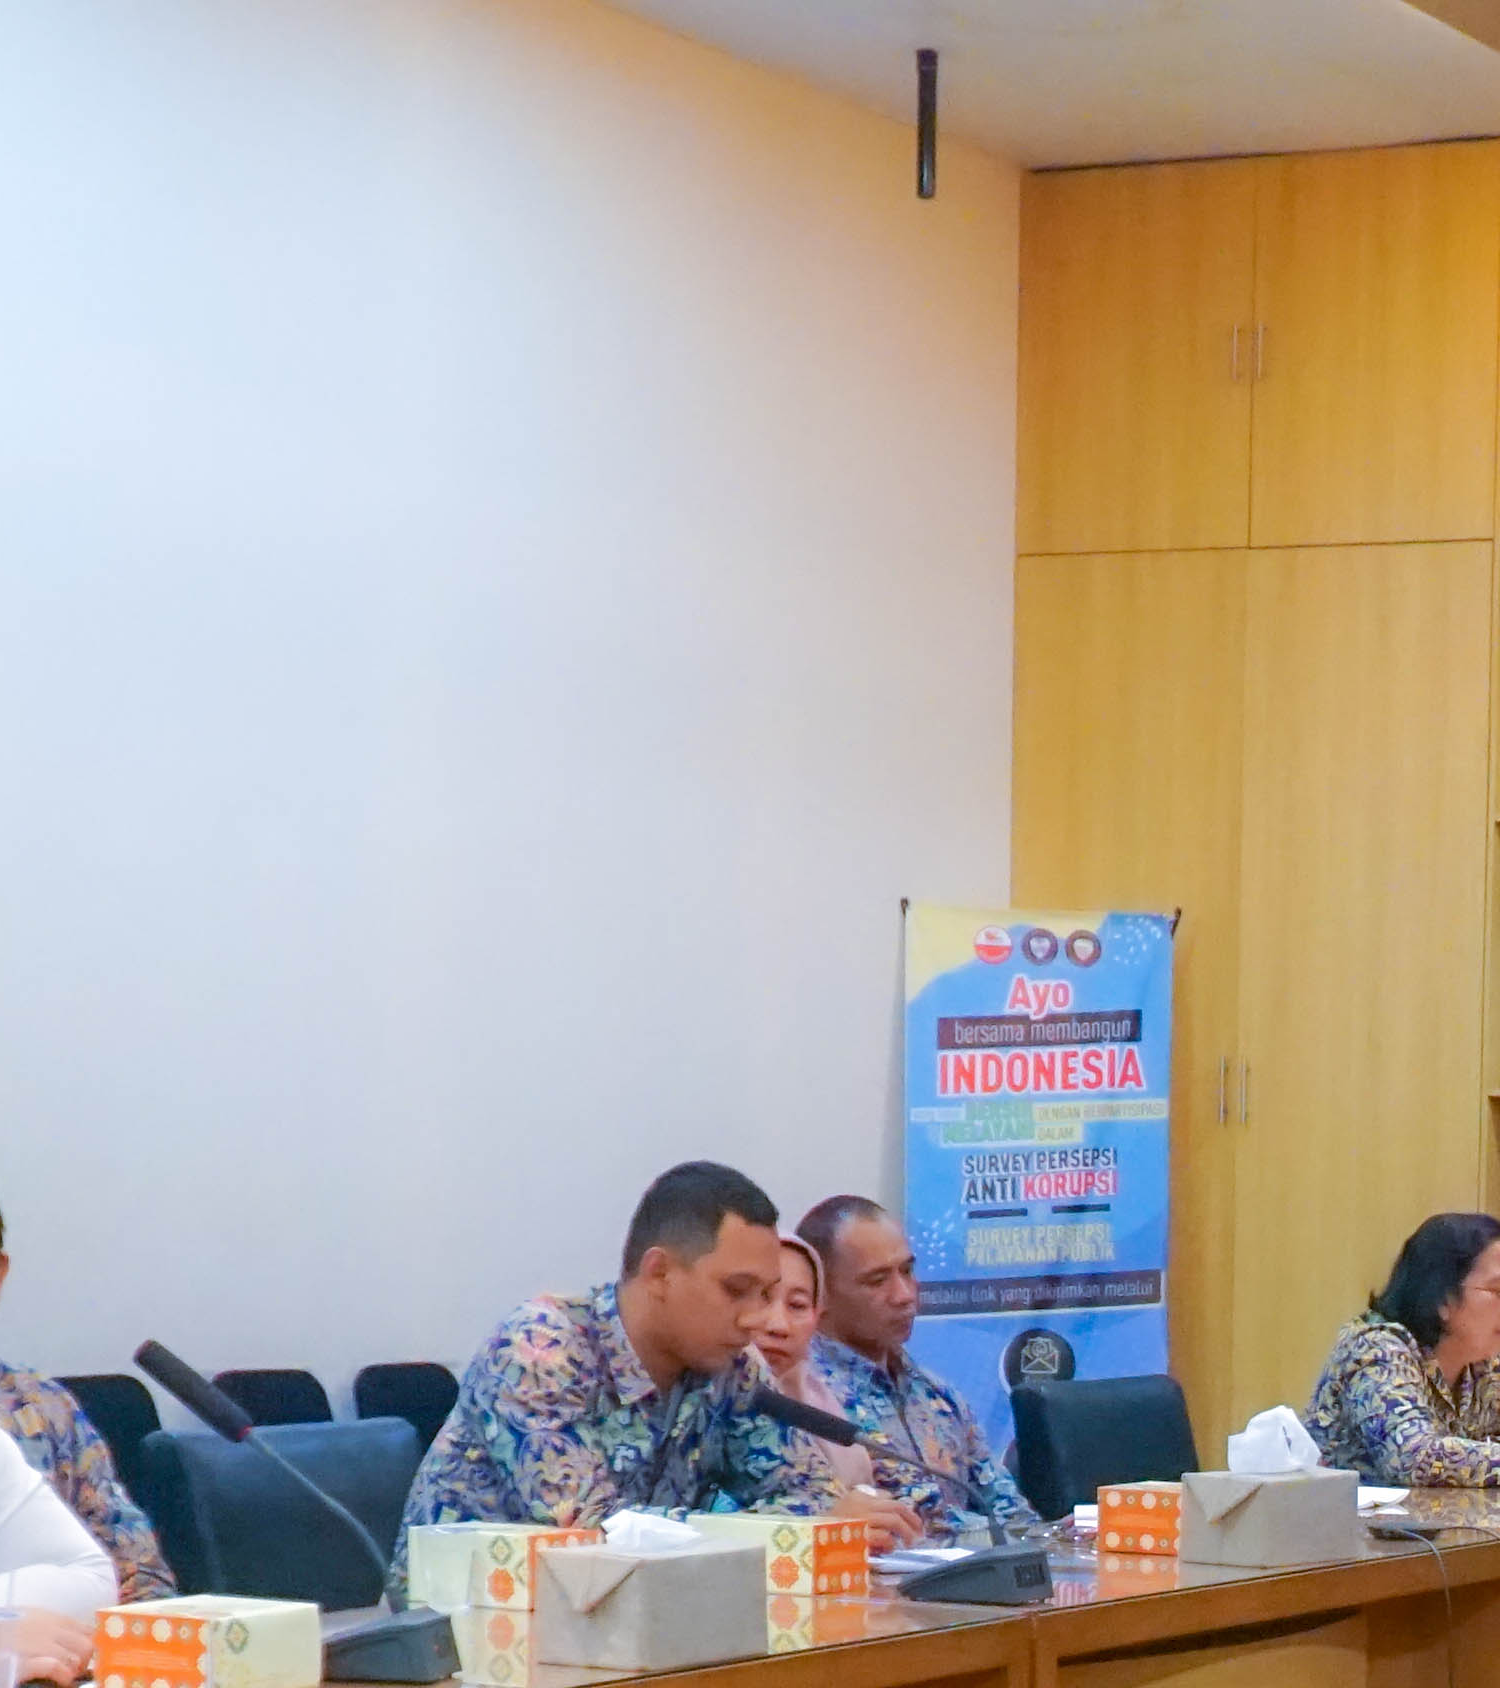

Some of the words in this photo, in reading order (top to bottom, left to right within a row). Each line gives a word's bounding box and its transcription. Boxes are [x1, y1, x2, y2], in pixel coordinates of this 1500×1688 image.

[1008, 975, 1071, 1016] Ayo
[954, 1021, 1025, 1045] bersama
[1030, 1018, 1132, 1044] membangun
[939, 1048, 1143, 1094] INDONESIA
[964, 1151, 1031, 1176] SURVEY
[1036, 1147, 1118, 1171] PERSEPSI
[964, 1174, 1017, 1204] ANTI
[1022, 1170, 1118, 1199] KORUPSI
